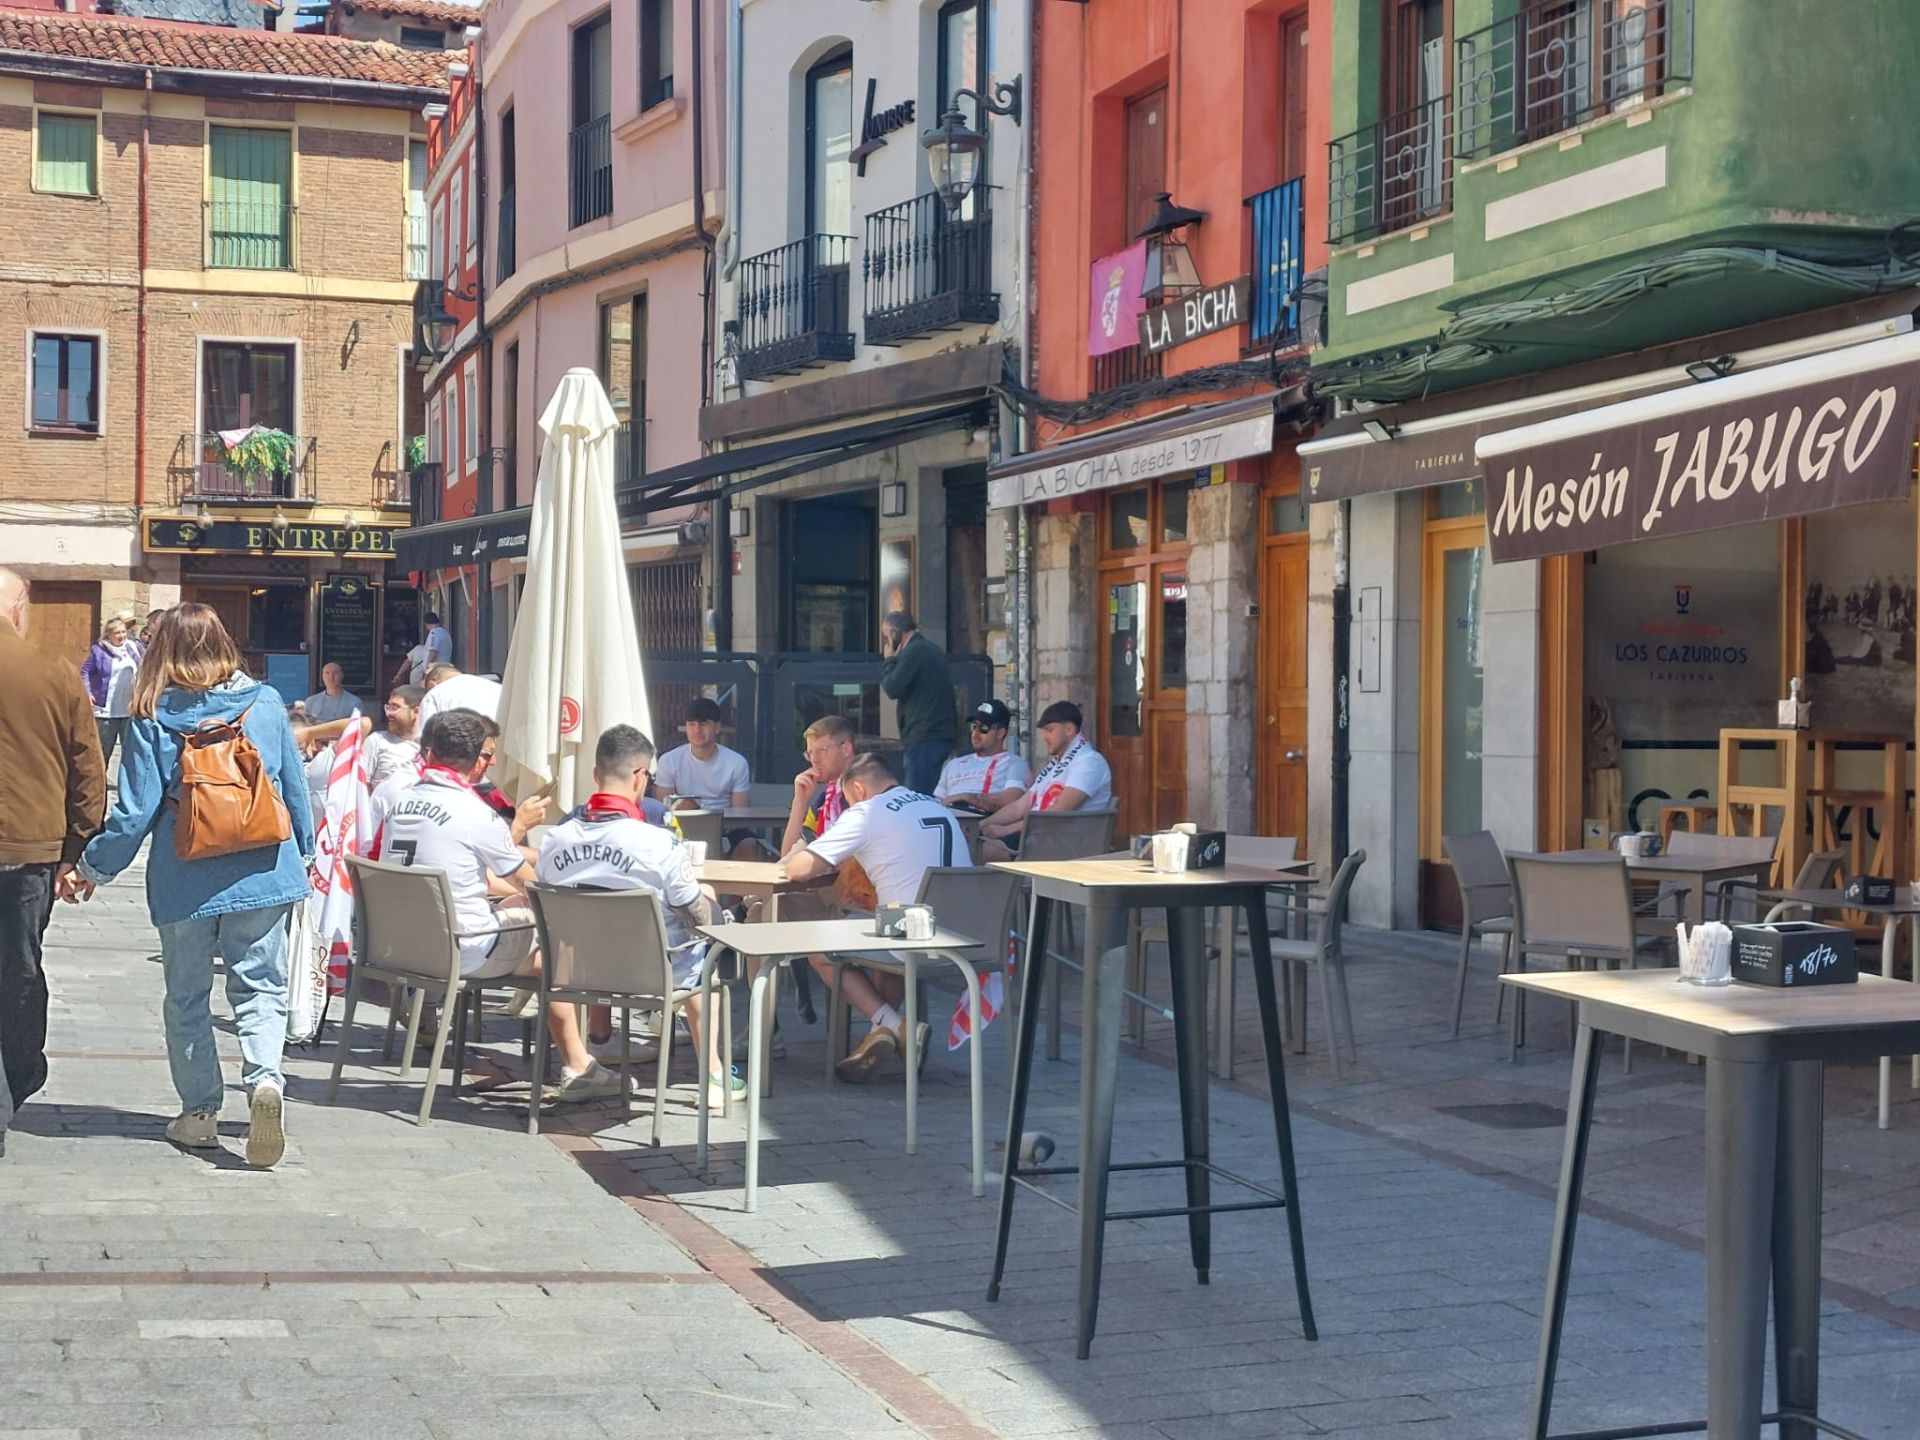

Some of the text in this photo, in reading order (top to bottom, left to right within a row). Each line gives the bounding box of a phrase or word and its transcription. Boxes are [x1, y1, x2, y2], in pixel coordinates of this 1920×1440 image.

[1146, 310, 1172, 349] LA
[1021, 474, 1047, 500] LA
[1131, 449, 1175, 476] desde
[1182, 433, 1223, 462] 1977
[1415, 452, 1463, 470] TABIERNA
[1493, 386, 1897, 537] Mesón JABUGO
[1615, 643, 1747, 664] LOS CAZURROS
[553, 844, 635, 874] CALDERÓN
[918, 816, 953, 867] 7
[1800, 943, 1838, 975] 18/70
